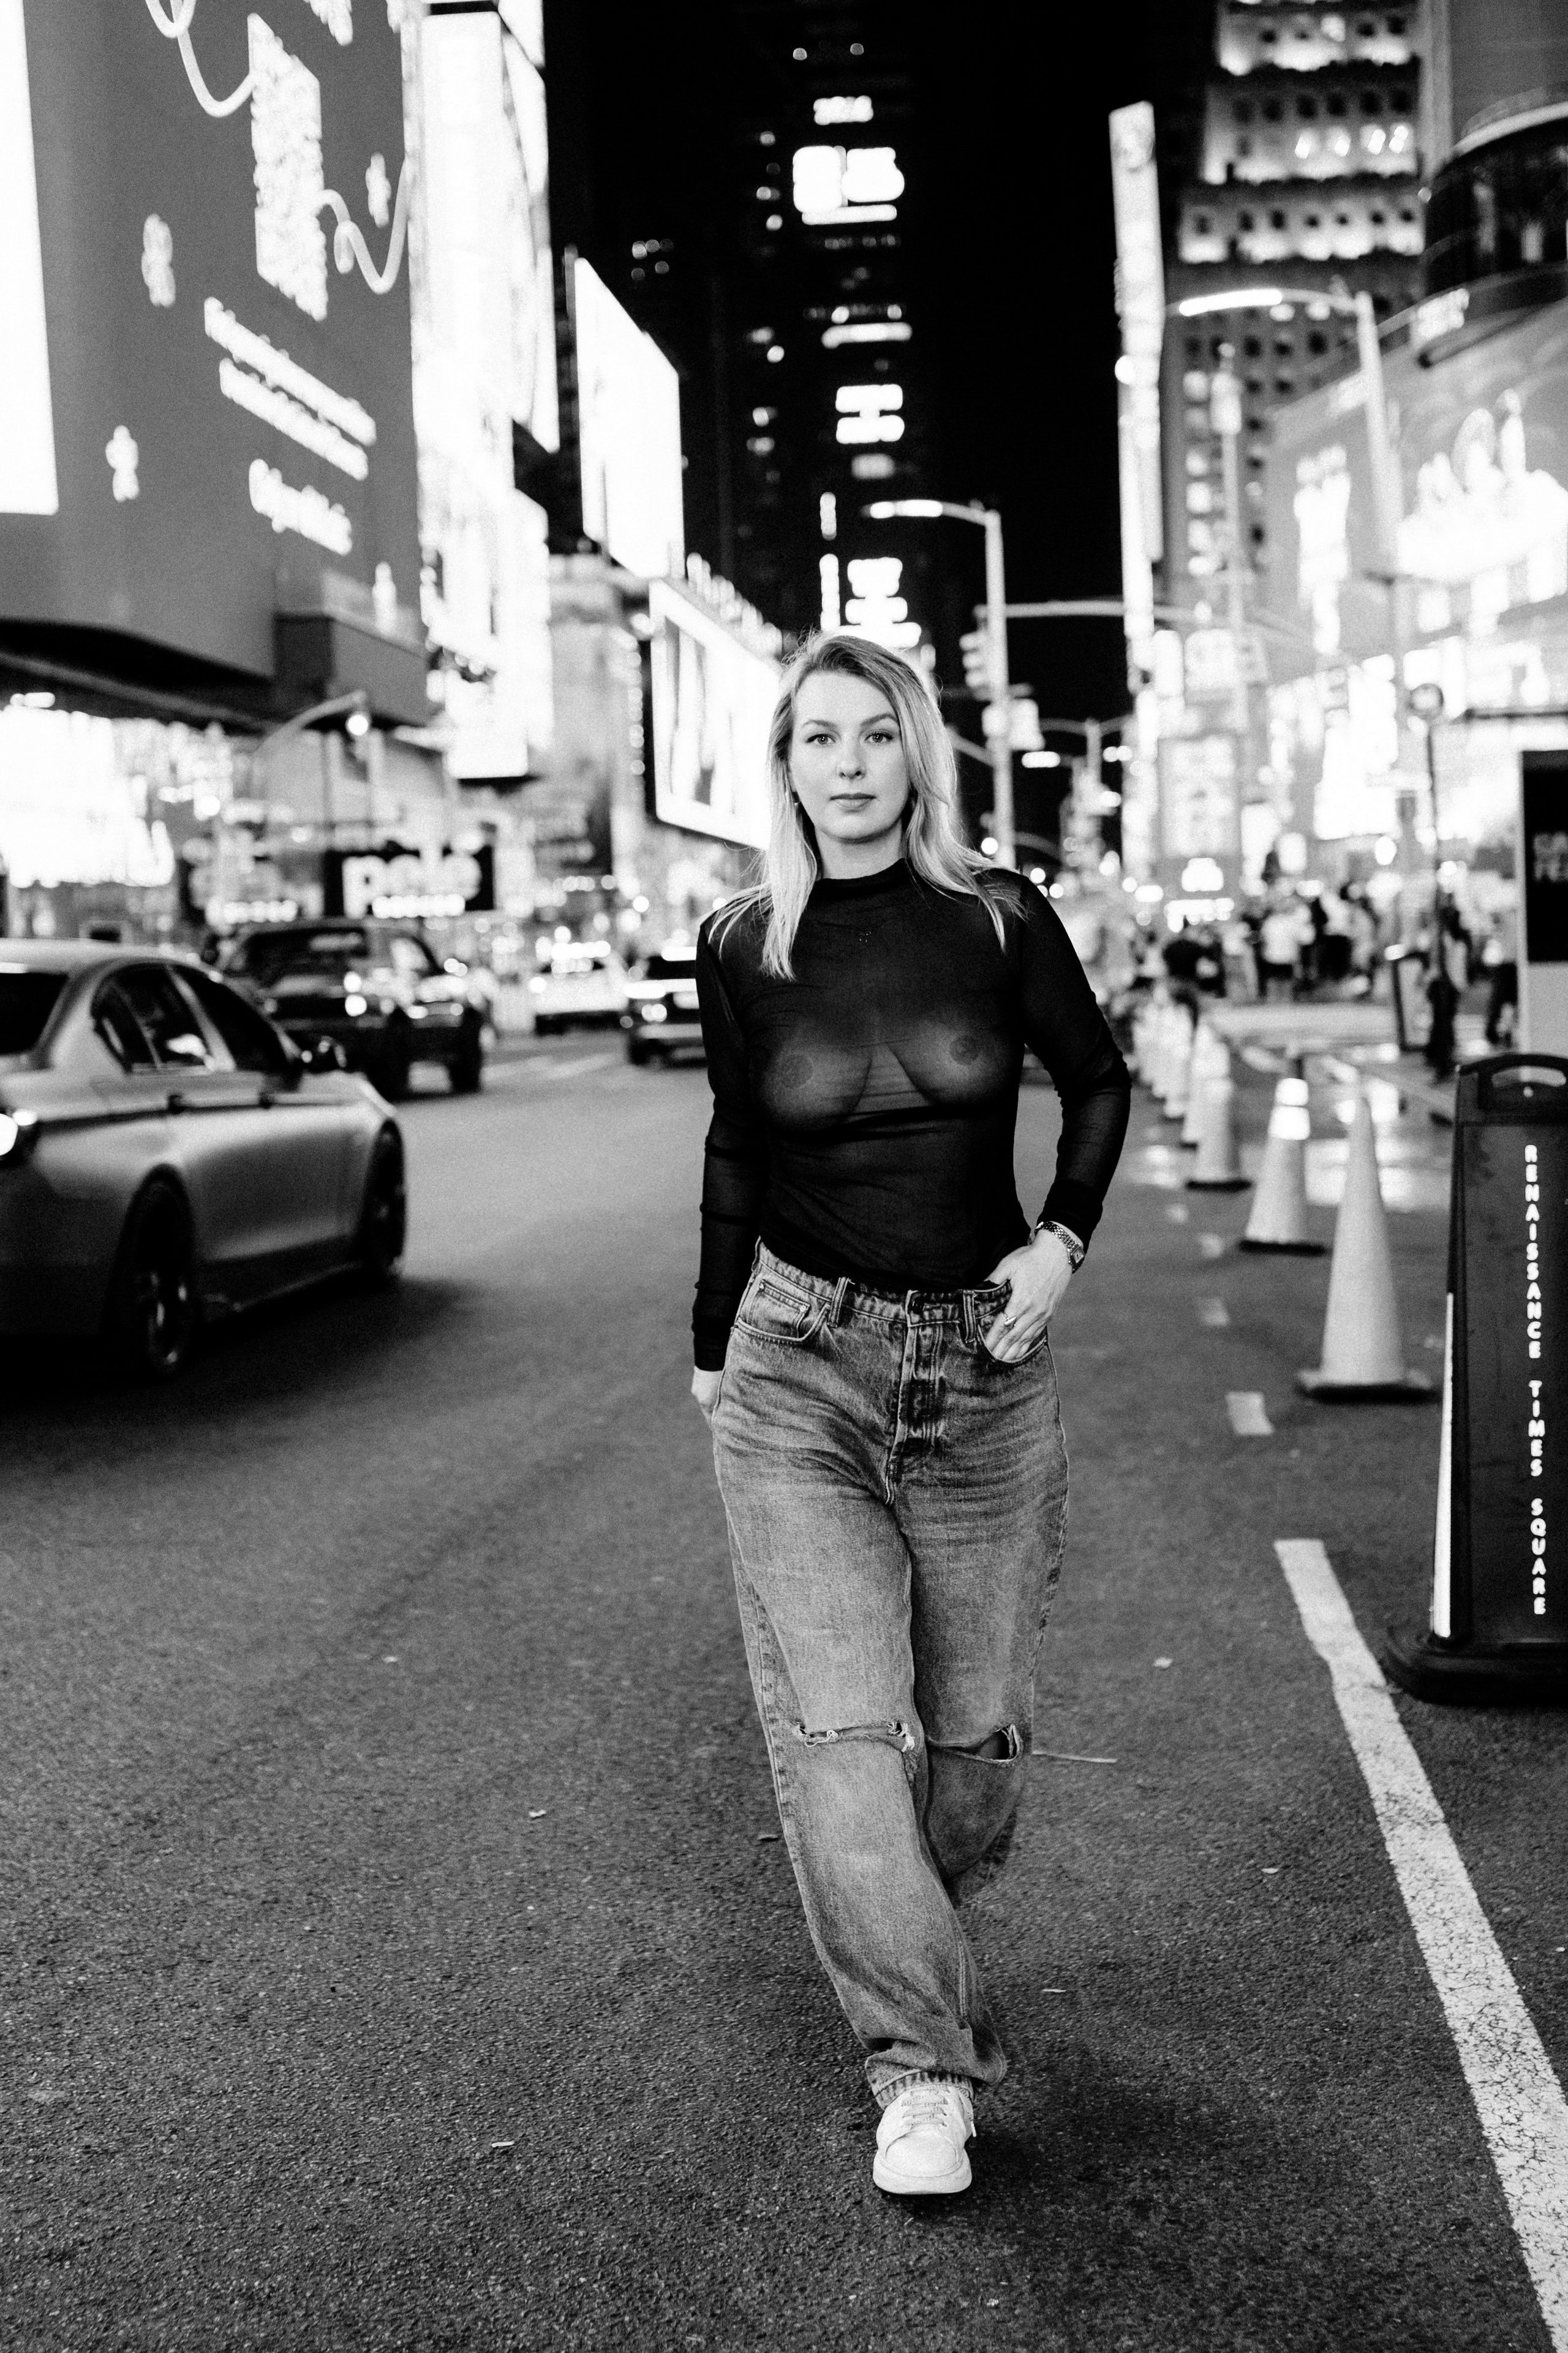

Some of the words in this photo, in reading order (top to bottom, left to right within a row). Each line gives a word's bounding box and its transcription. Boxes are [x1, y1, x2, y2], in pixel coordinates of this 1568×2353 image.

[1525, 1144, 1542, 1359] RENAISSANCE
[1528, 1380, 1545, 1477] TIMES
[1530, 1498, 1547, 1615] SQUARE
